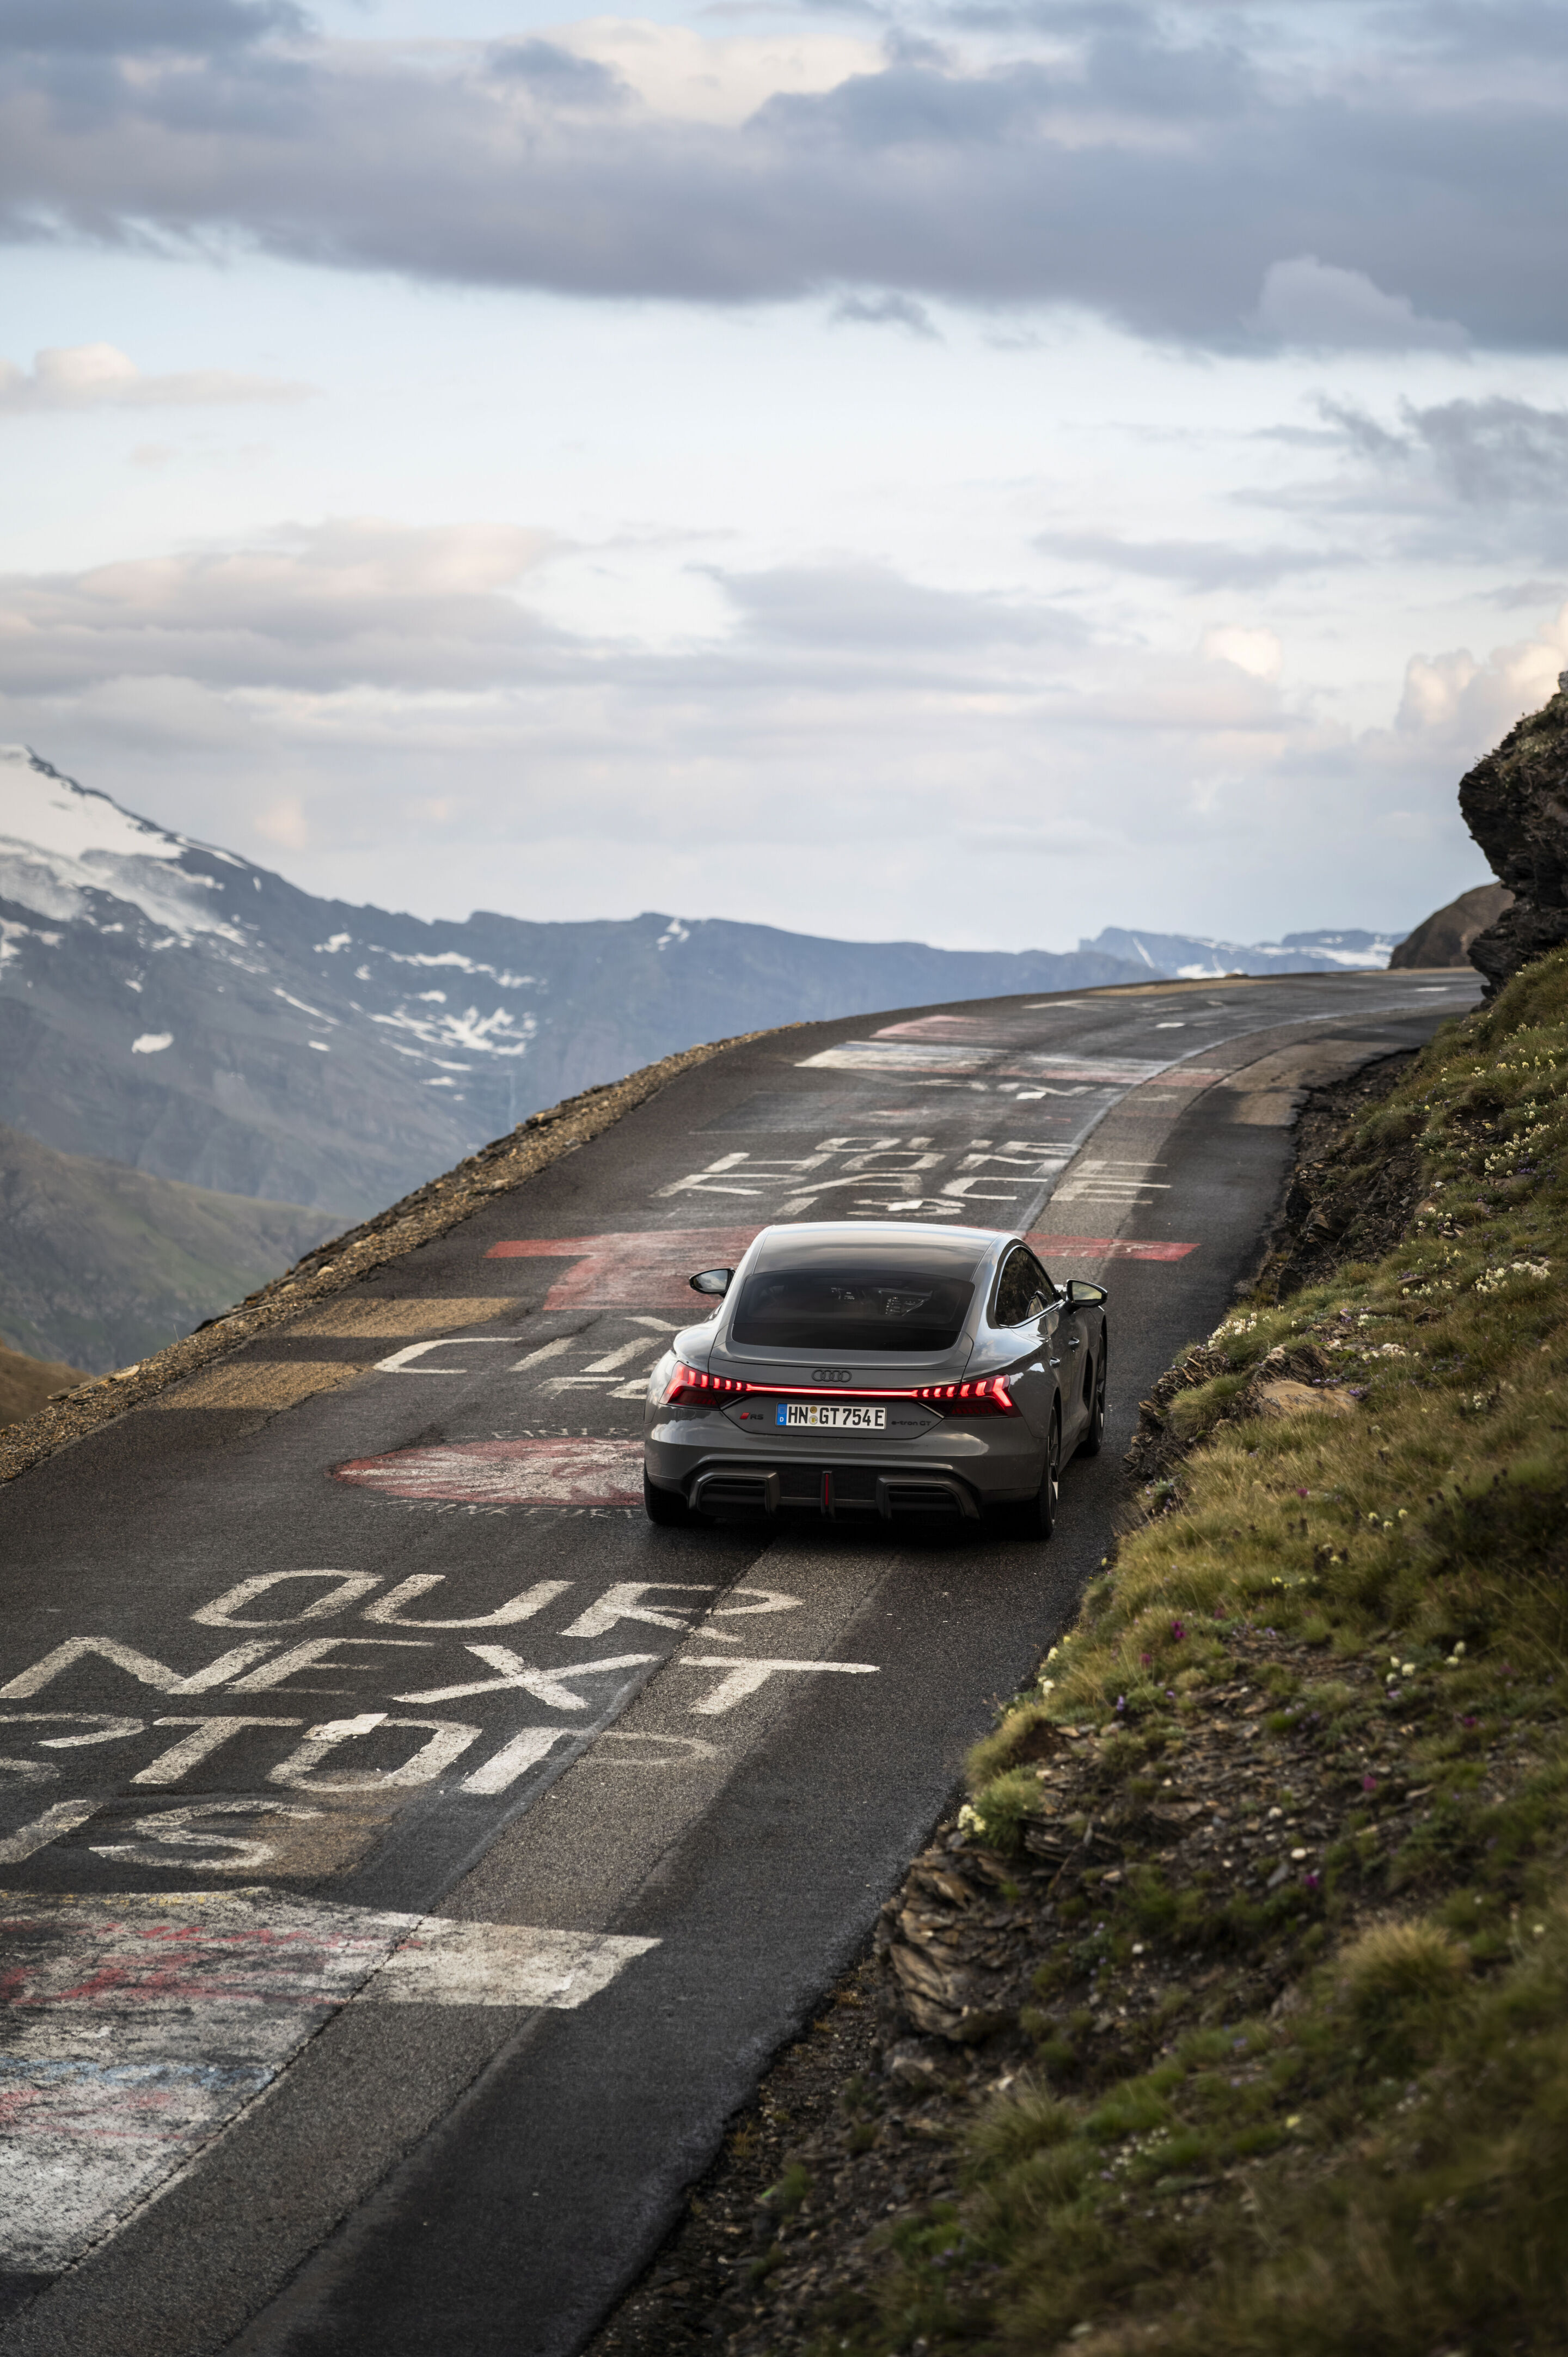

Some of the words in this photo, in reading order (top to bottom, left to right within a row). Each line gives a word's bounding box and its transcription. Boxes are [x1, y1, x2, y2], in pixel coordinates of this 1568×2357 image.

[703, 1153, 1167, 1179] HOME
[655, 1172, 1172, 1204] RACE
[774, 1198, 966, 1217] IS
[788, 1406, 808, 1424] HN
[819, 1407, 840, 1425] GT
[189, 1570, 804, 1641] OUR
[0, 1637, 880, 1715] NEXT
